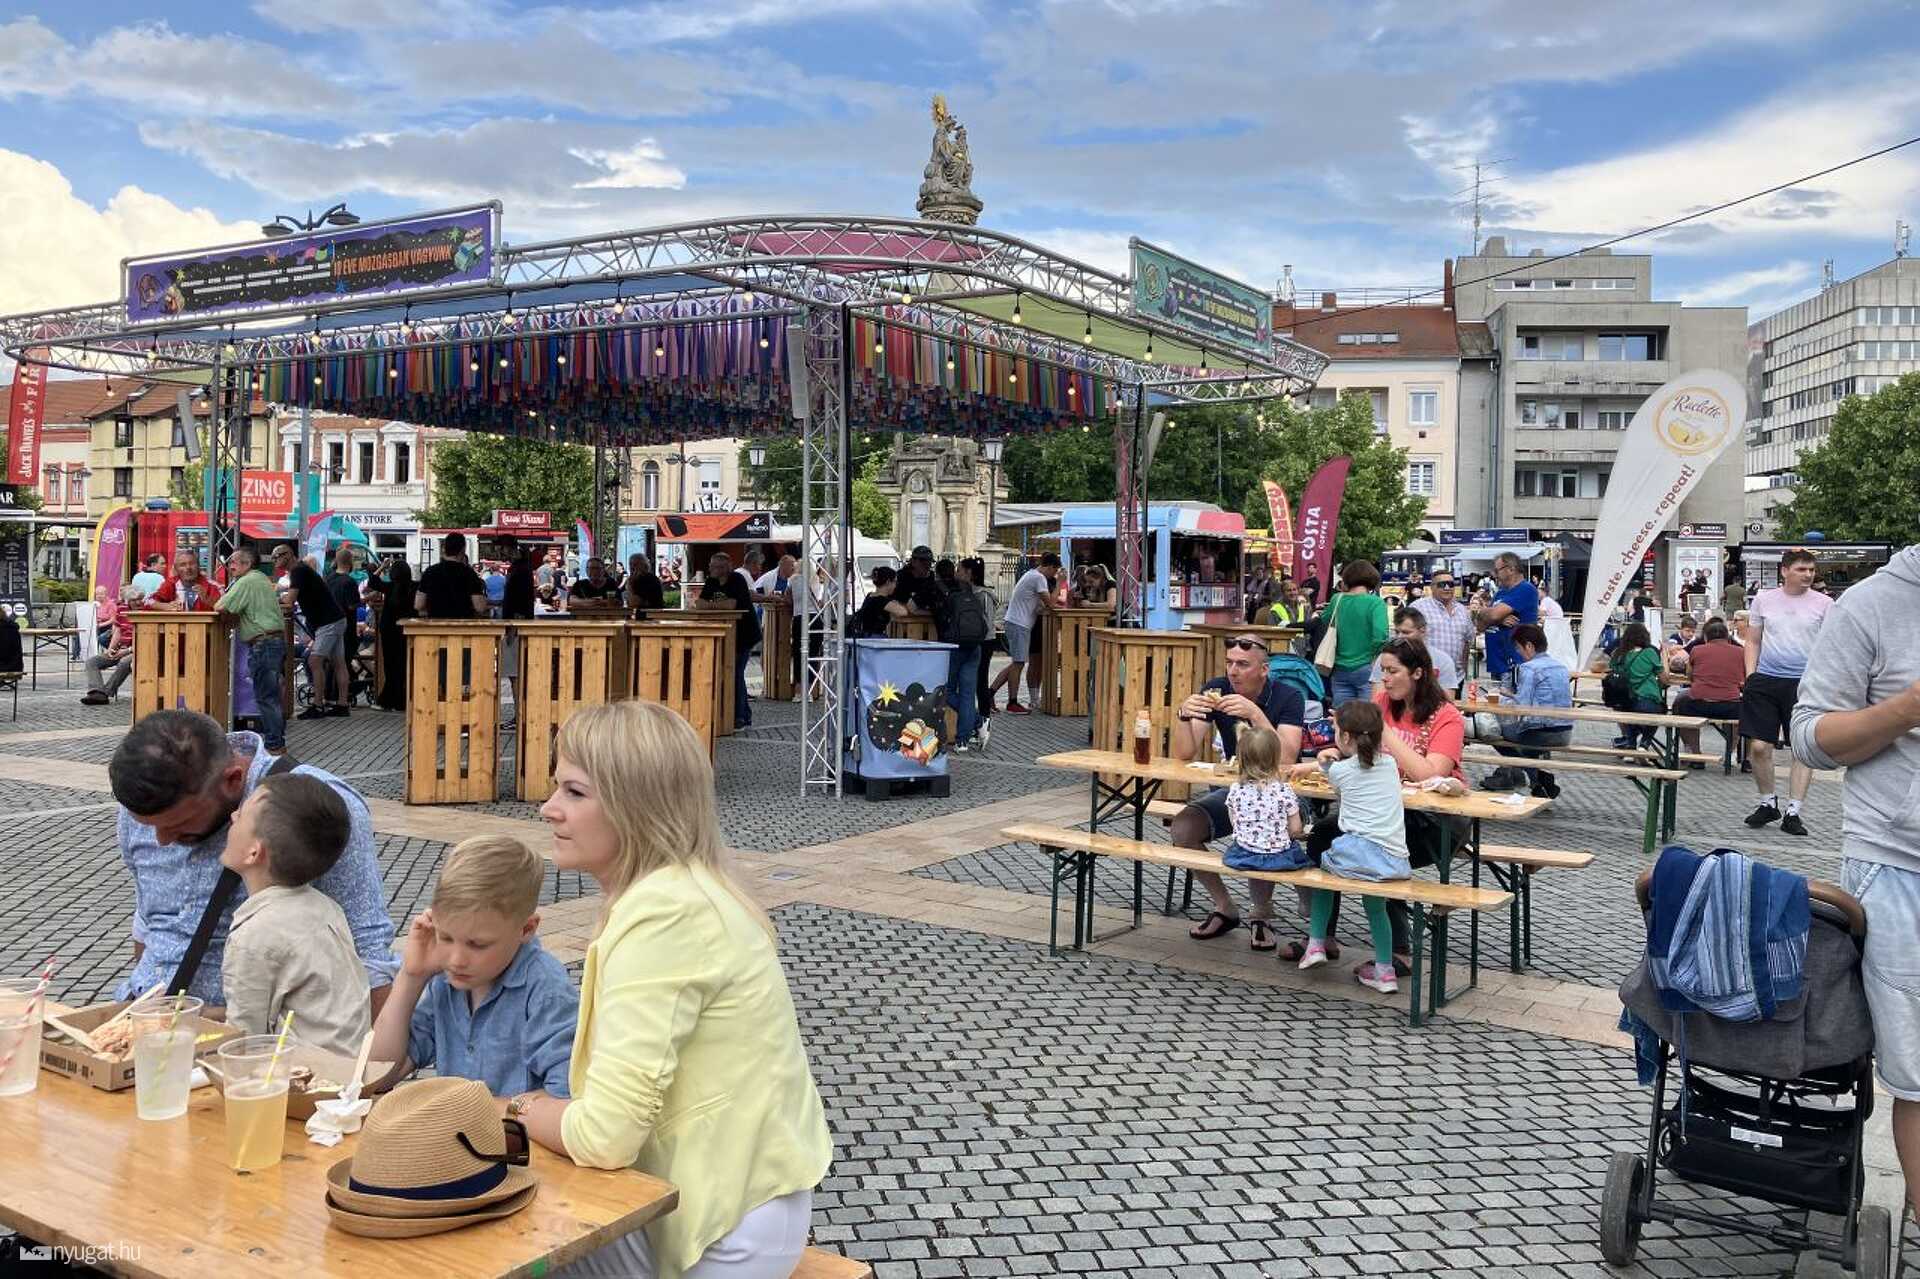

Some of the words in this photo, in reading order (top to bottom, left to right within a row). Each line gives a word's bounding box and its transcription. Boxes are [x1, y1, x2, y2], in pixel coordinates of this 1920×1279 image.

[26, 367, 40, 396] FIR
[241, 478, 286, 498] ZING
[344, 515, 362, 524] ANS
[364, 515, 393, 524] STORE
[1301, 507, 1321, 560] COSTA
[1597, 569, 1625, 606] taste.
[1620, 519, 1658, 566] cheese.
[1655, 463, 1696, 516] repeat!
